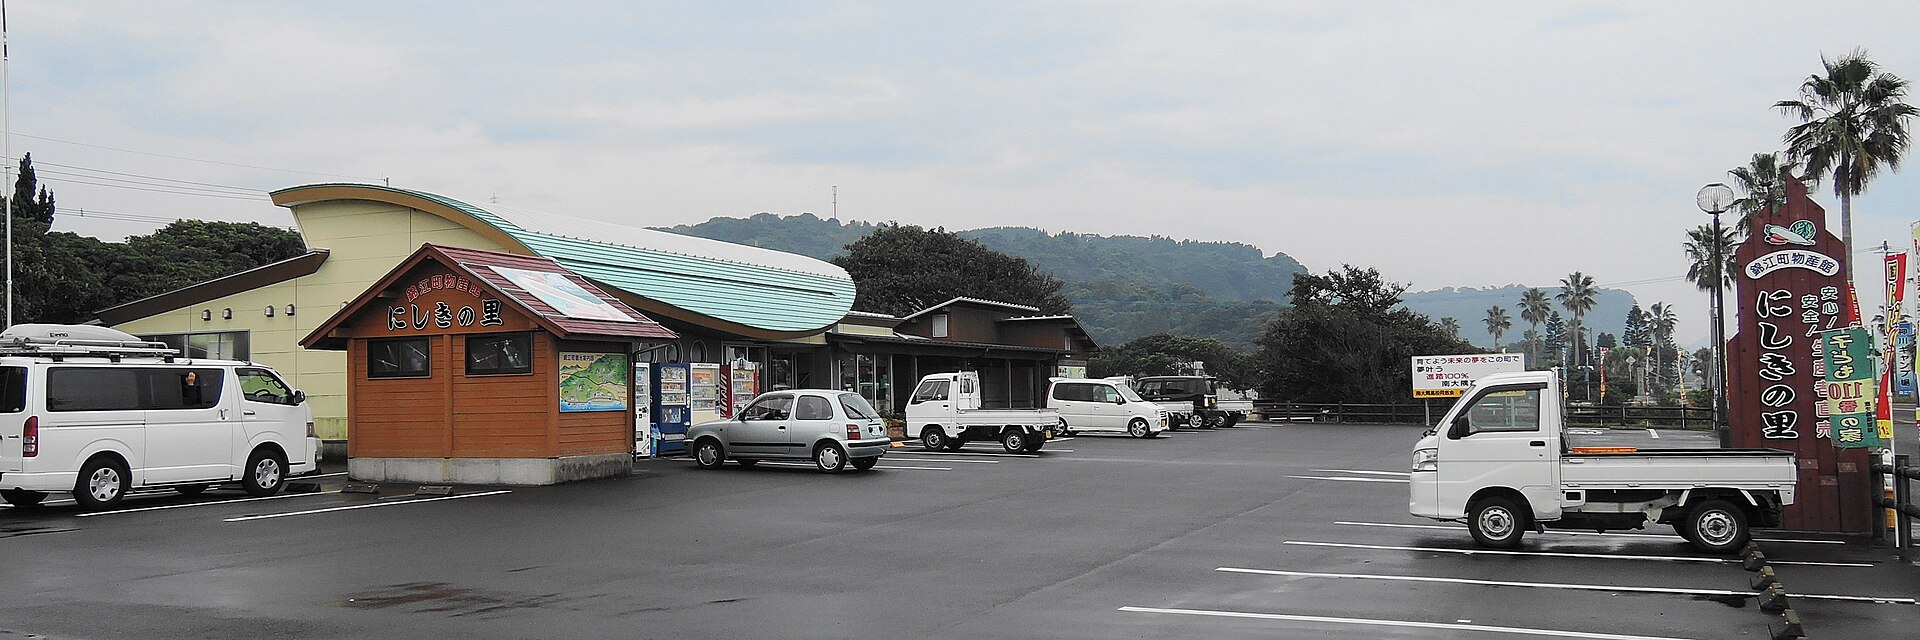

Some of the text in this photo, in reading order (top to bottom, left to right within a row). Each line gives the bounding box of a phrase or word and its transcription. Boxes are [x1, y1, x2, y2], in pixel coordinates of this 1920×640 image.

[1750, 252, 1835, 276] 錦江町物産館
[387, 299, 503, 331] にしきの里
[1416, 356, 1520, 365] 育てよう未来の夢をこの町で
[1756, 289, 1799, 439] にしきの里
